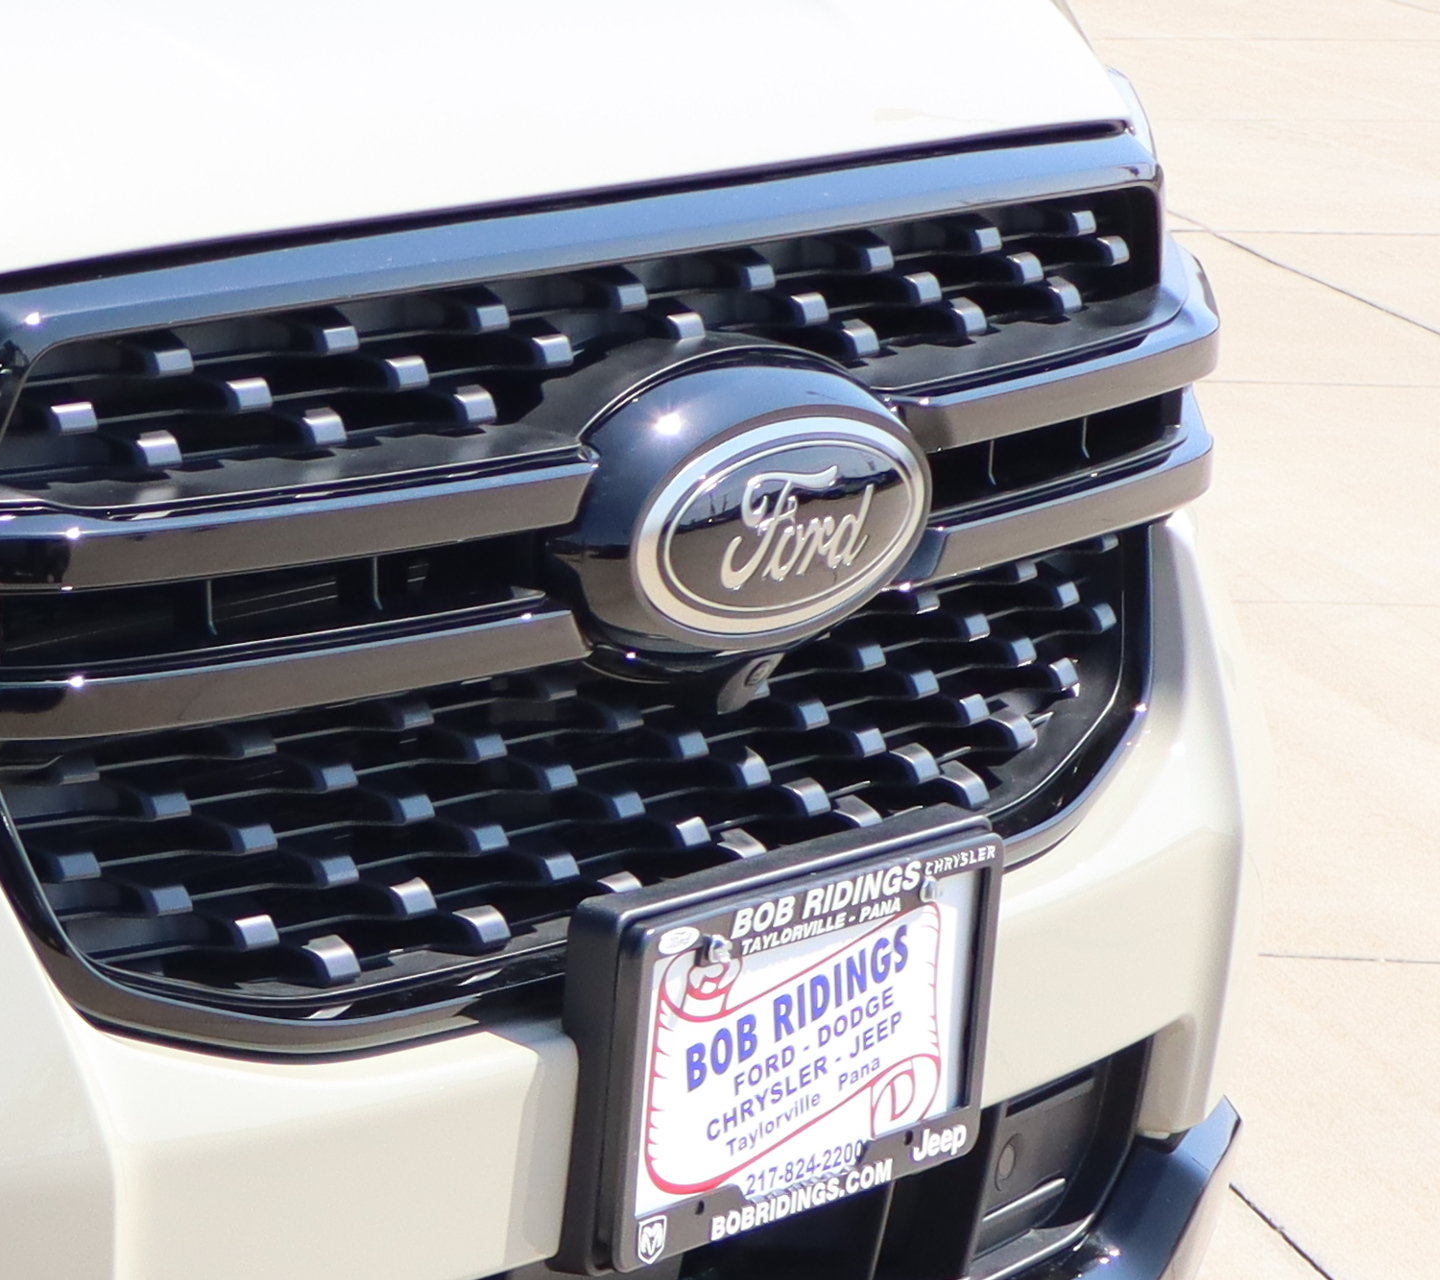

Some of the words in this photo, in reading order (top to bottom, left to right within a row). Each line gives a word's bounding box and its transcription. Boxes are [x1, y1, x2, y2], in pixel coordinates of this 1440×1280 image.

[720, 465, 875, 590] Ford
[731, 896, 796, 939] BOB
[802, 861, 922, 920] RIDINGS
[925, 844, 996, 876] CHRYSLER
[741, 912, 846, 955] TAYLORVILLE
[858, 897, 902, 923] PANA
[686, 1013, 758, 1092] BOB
[773, 924, 909, 1043] RIDINGS
[733, 1045, 796, 1096] FORD
[817, 986, 895, 1049] DODGE
[706, 1056, 829, 1141] CHRYSLER
[849, 1011, 903, 1059] JEEP
[725, 1091, 822, 1157] Taylorville
[837, 1056, 881, 1092] Pana
[745, 1139, 865, 1196] 217-824-2200
[913, 1124, 968, 1162] Jeep
[710, 1158, 893, 1241] BOBRIDINGS.COM
